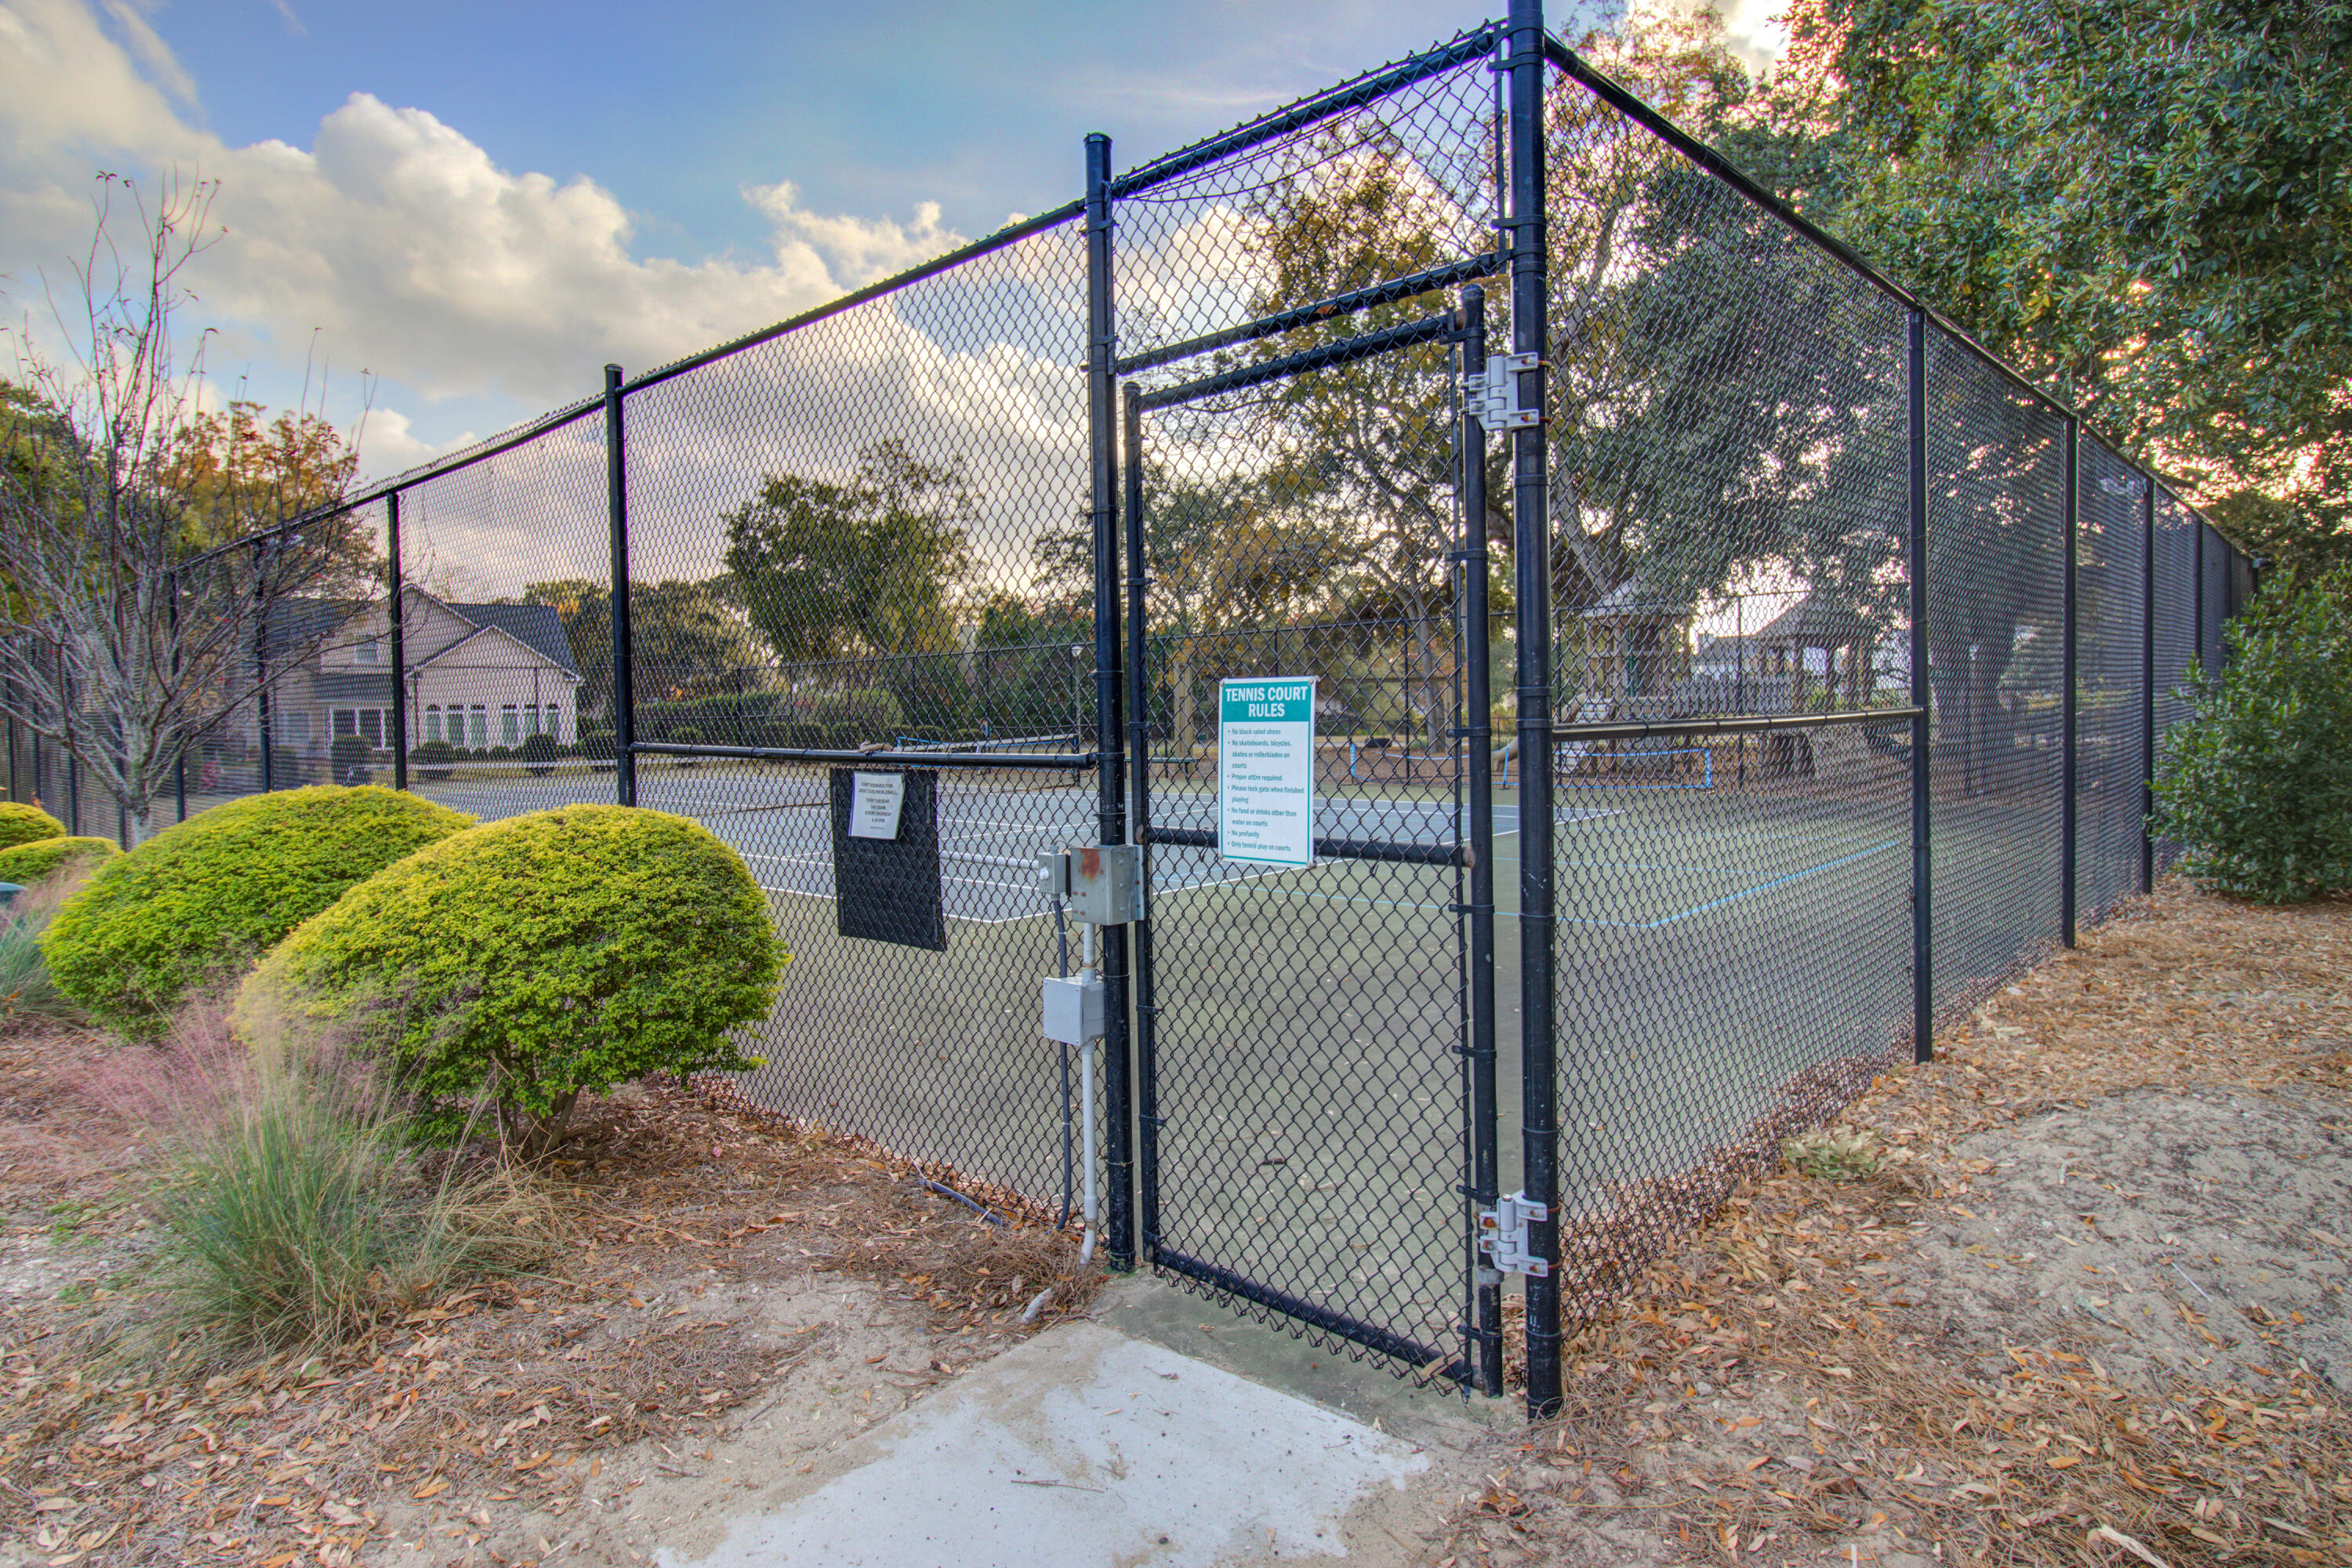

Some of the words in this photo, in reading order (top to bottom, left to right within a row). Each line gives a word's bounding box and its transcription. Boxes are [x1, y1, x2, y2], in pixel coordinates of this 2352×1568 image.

[1225, 687, 1265, 702] TENNIS
[1268, 686, 1308, 701] COURT
[1248, 703, 1285, 717] RULES
